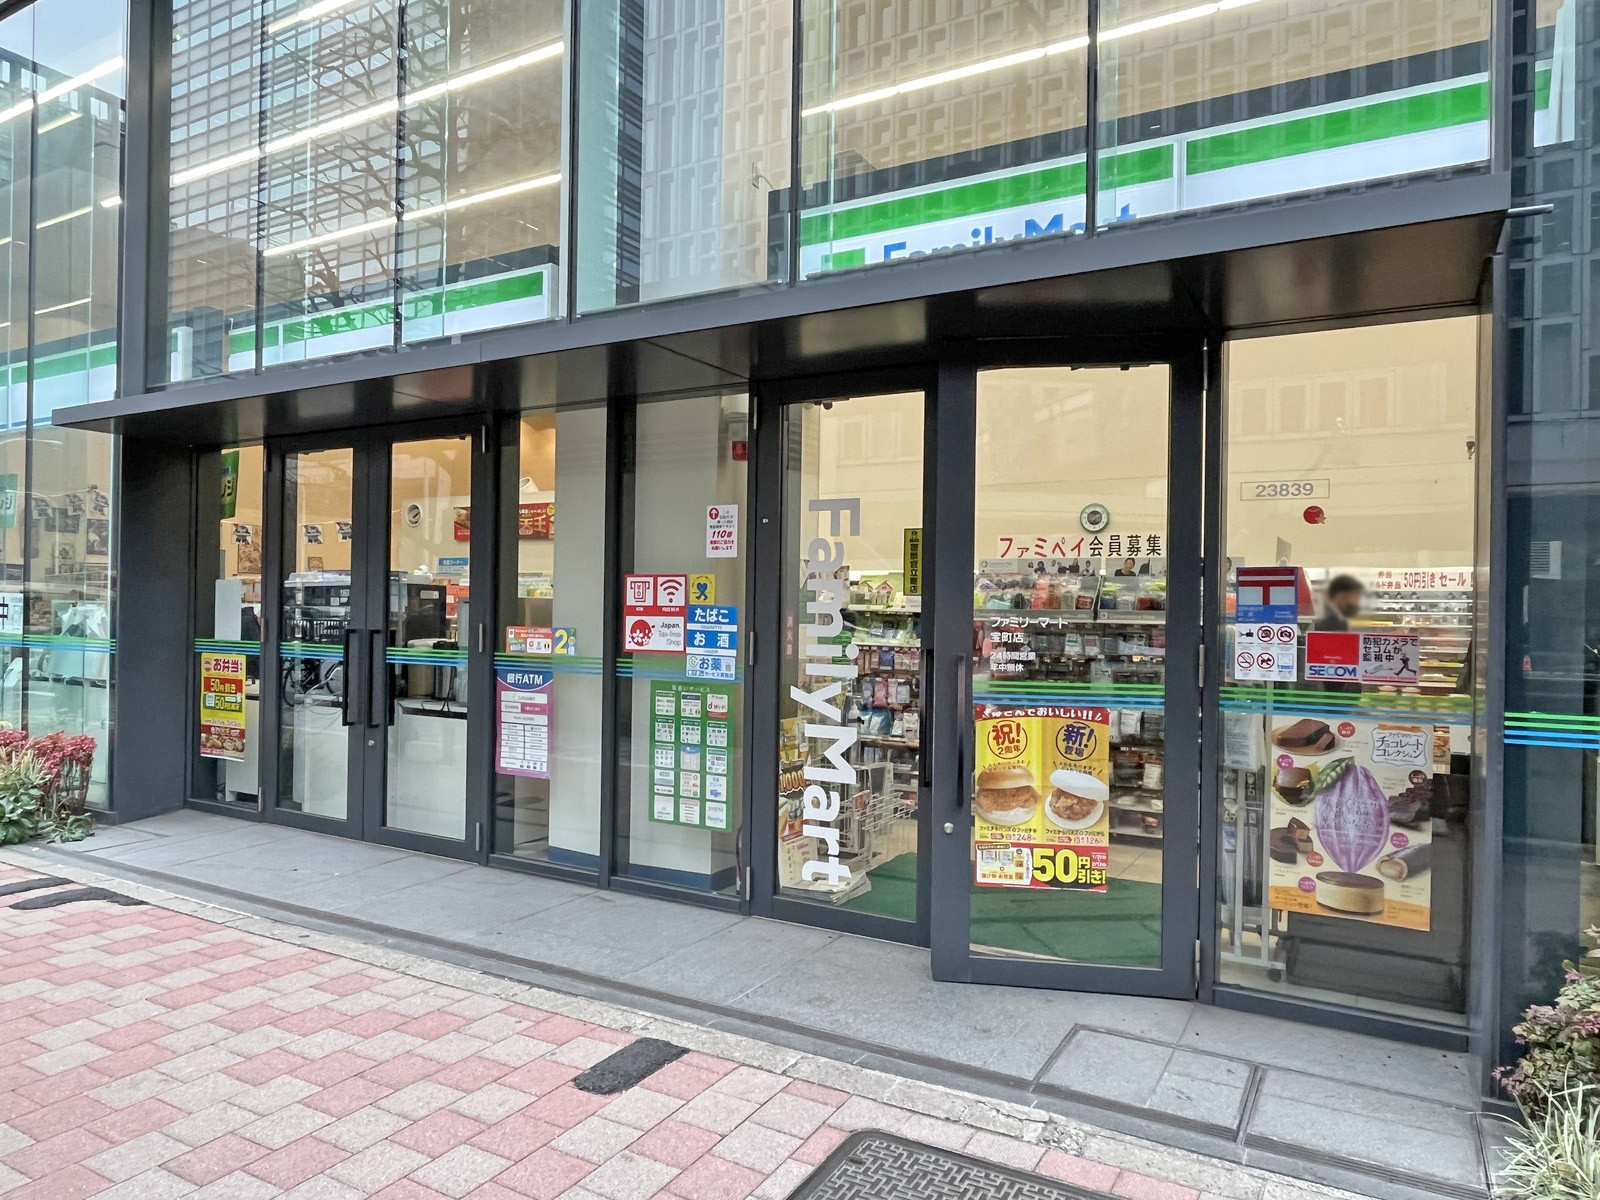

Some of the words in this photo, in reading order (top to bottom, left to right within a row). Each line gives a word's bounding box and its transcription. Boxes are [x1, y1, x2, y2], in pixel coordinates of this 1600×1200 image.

[1256, 482, 1314, 498] 23839
[999, 534, 1162, 558] ファミペイ会員募集
[1403, 572, 1436, 588] 50円引き
[1439, 573, 1467, 587] セール
[694, 607, 729, 622] たばこ
[990, 616, 1068, 630] ファミリーマート
[555, 629, 568, 654] 2
[694, 631, 729, 648] お酒
[990, 632, 1024, 643] 宝町店
[1362, 636, 1418, 647] 防犯カメラで
[990, 651, 1036, 661] 24時間営業
[1363, 646, 1402, 654] セコムが
[699, 657, 722, 671] お薬
[1362, 653, 1394, 662] 監視中
[213, 659, 239, 672] お弁当
[990, 663, 1024, 672] 年中無休
[1308, 665, 1357, 677] SECOM
[506, 672, 543, 685] 銀行ATM
[790, 497, 861, 886] FamilyMart
[992, 722, 1021, 746] 祝!
[1062, 723, 1095, 749] 新!
[1376, 736, 1423, 750] チョコレート
[998, 745, 1021, 755] 2周年
[1064, 746, 1085, 757] 登場
[1376, 748, 1424, 759] コレクション
